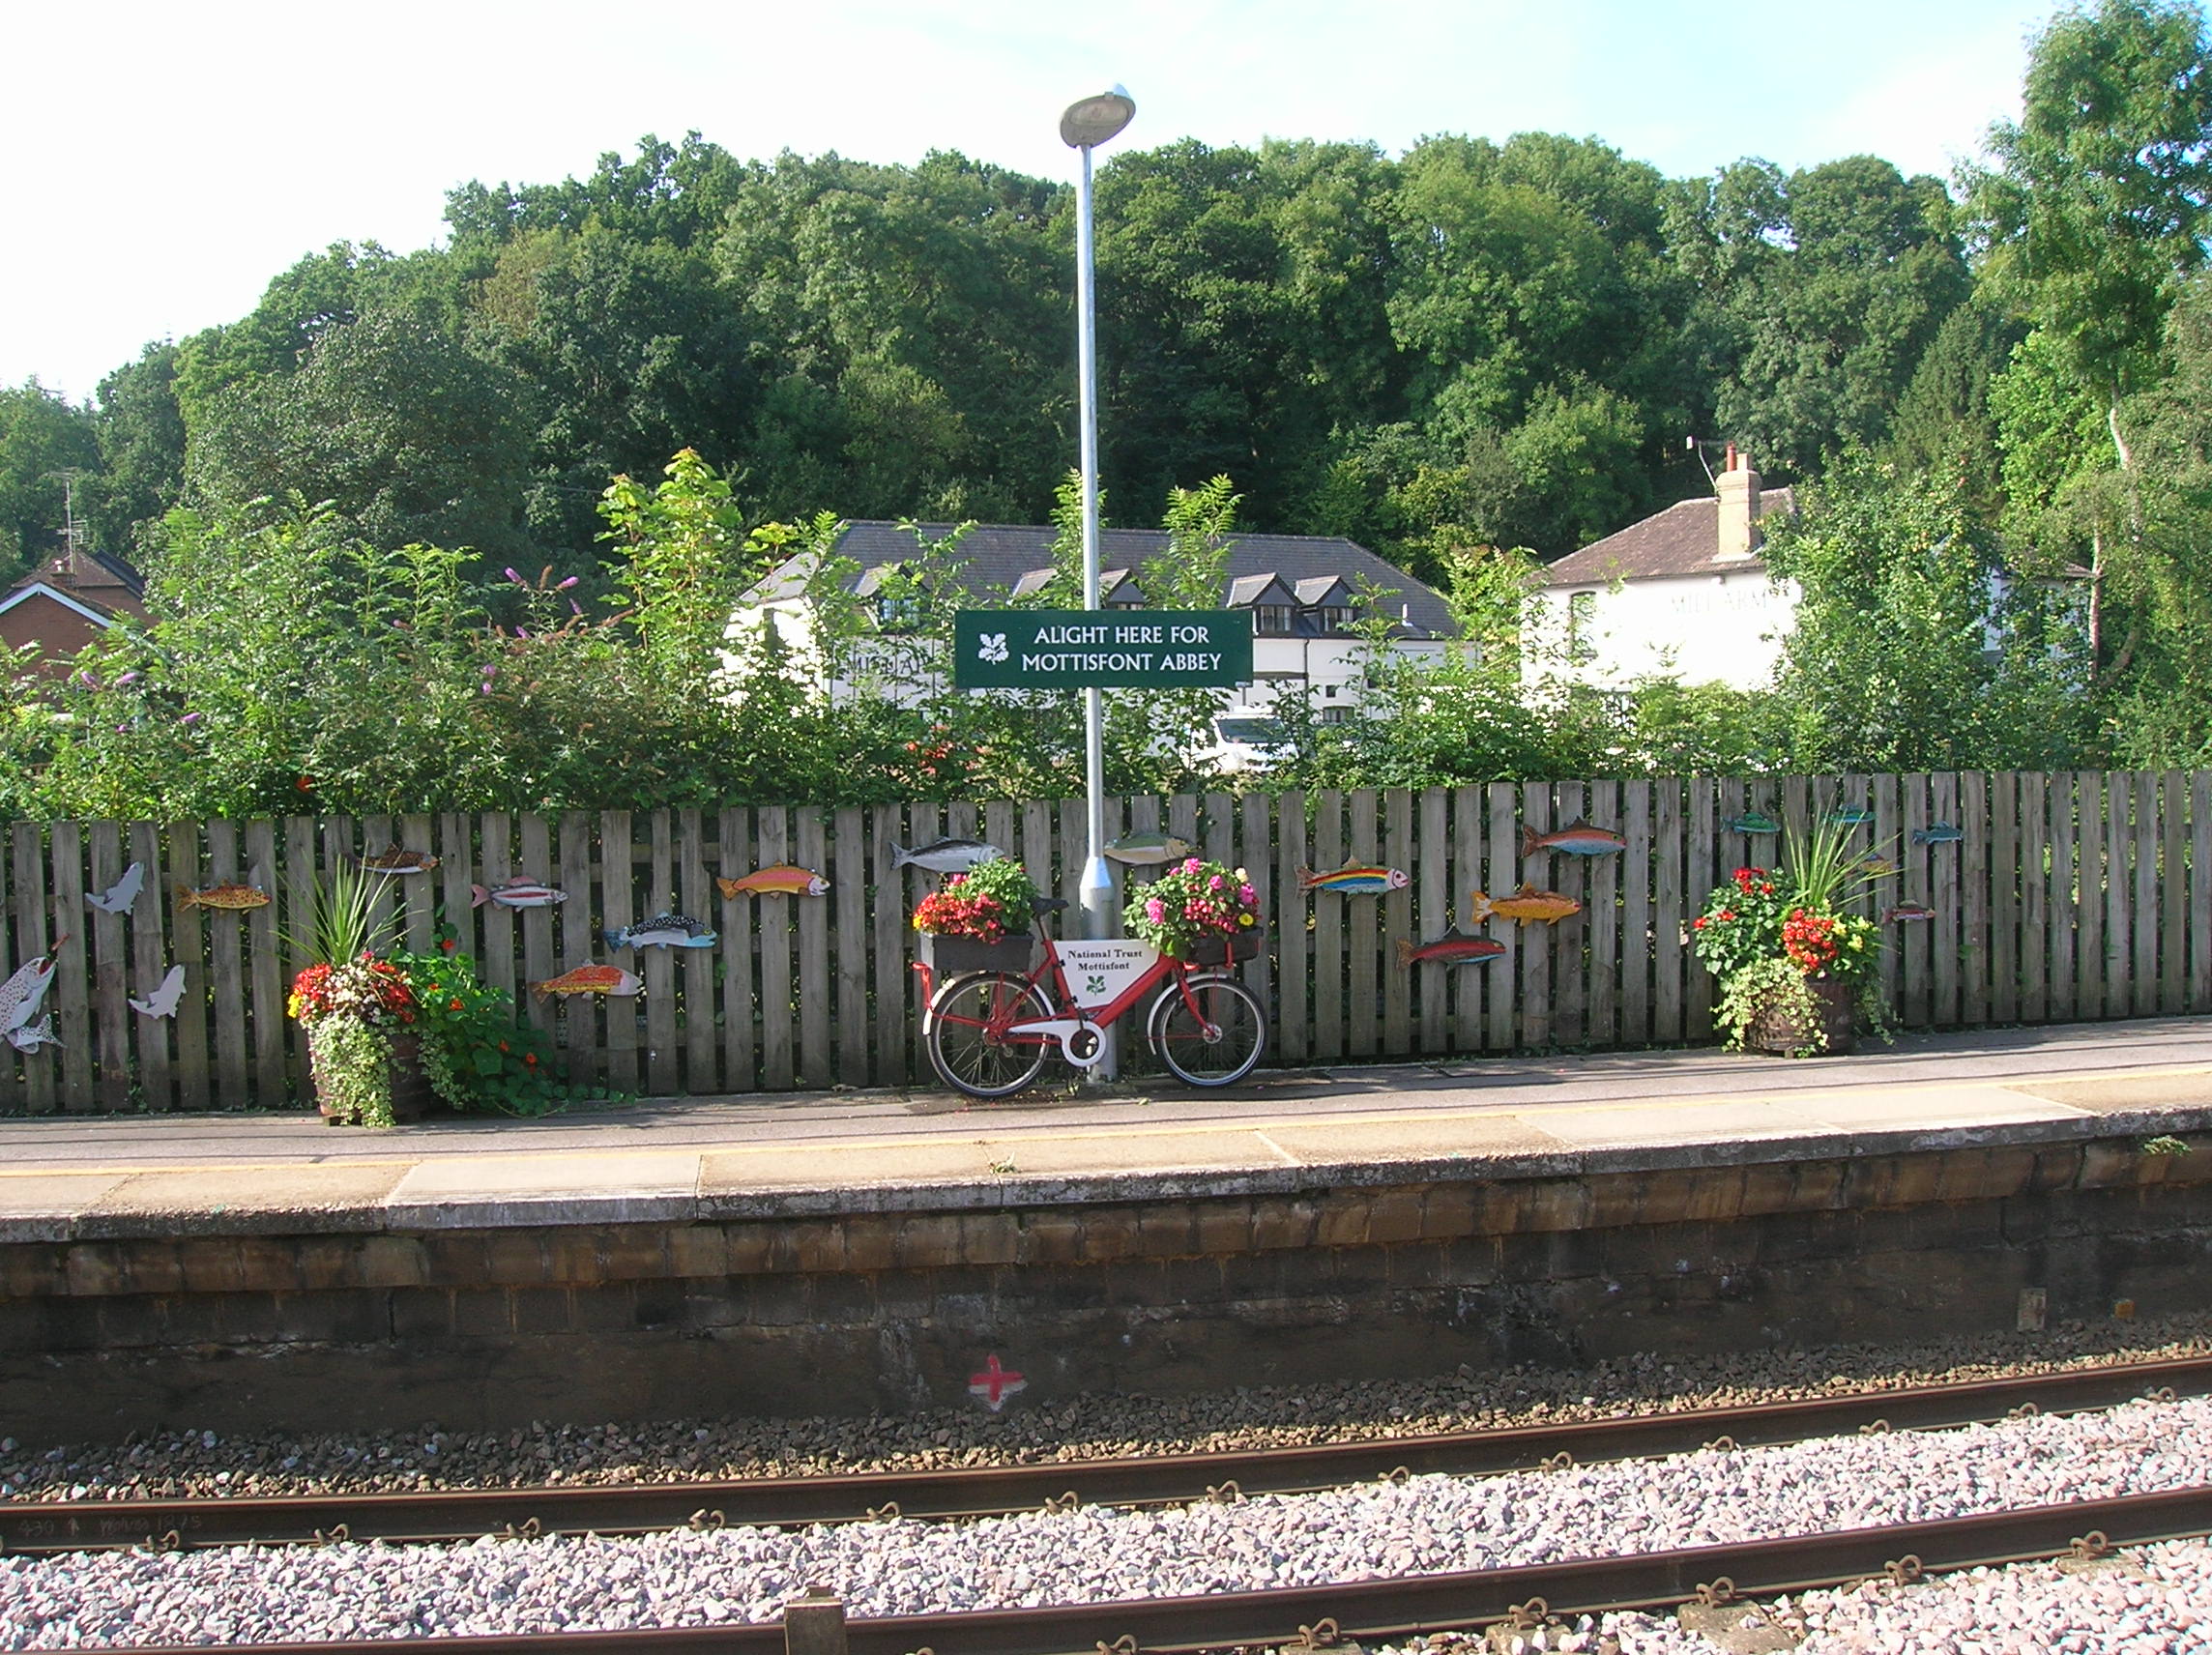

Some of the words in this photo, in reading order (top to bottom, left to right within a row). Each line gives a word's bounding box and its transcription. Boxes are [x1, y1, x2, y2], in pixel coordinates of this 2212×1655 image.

[1033, 625, 1108, 644] ALIGHT
[1115, 625, 1163, 644] HERE
[1171, 625, 1210, 644] FOR
[1021, 653, 1153, 672] MOTTISFONT
[1159, 653, 1222, 671] ABBEY
[1067, 949, 1111, 959] National
[1114, 948, 1143, 958] Trust
[1078, 962, 1130, 972] Mottisfont
